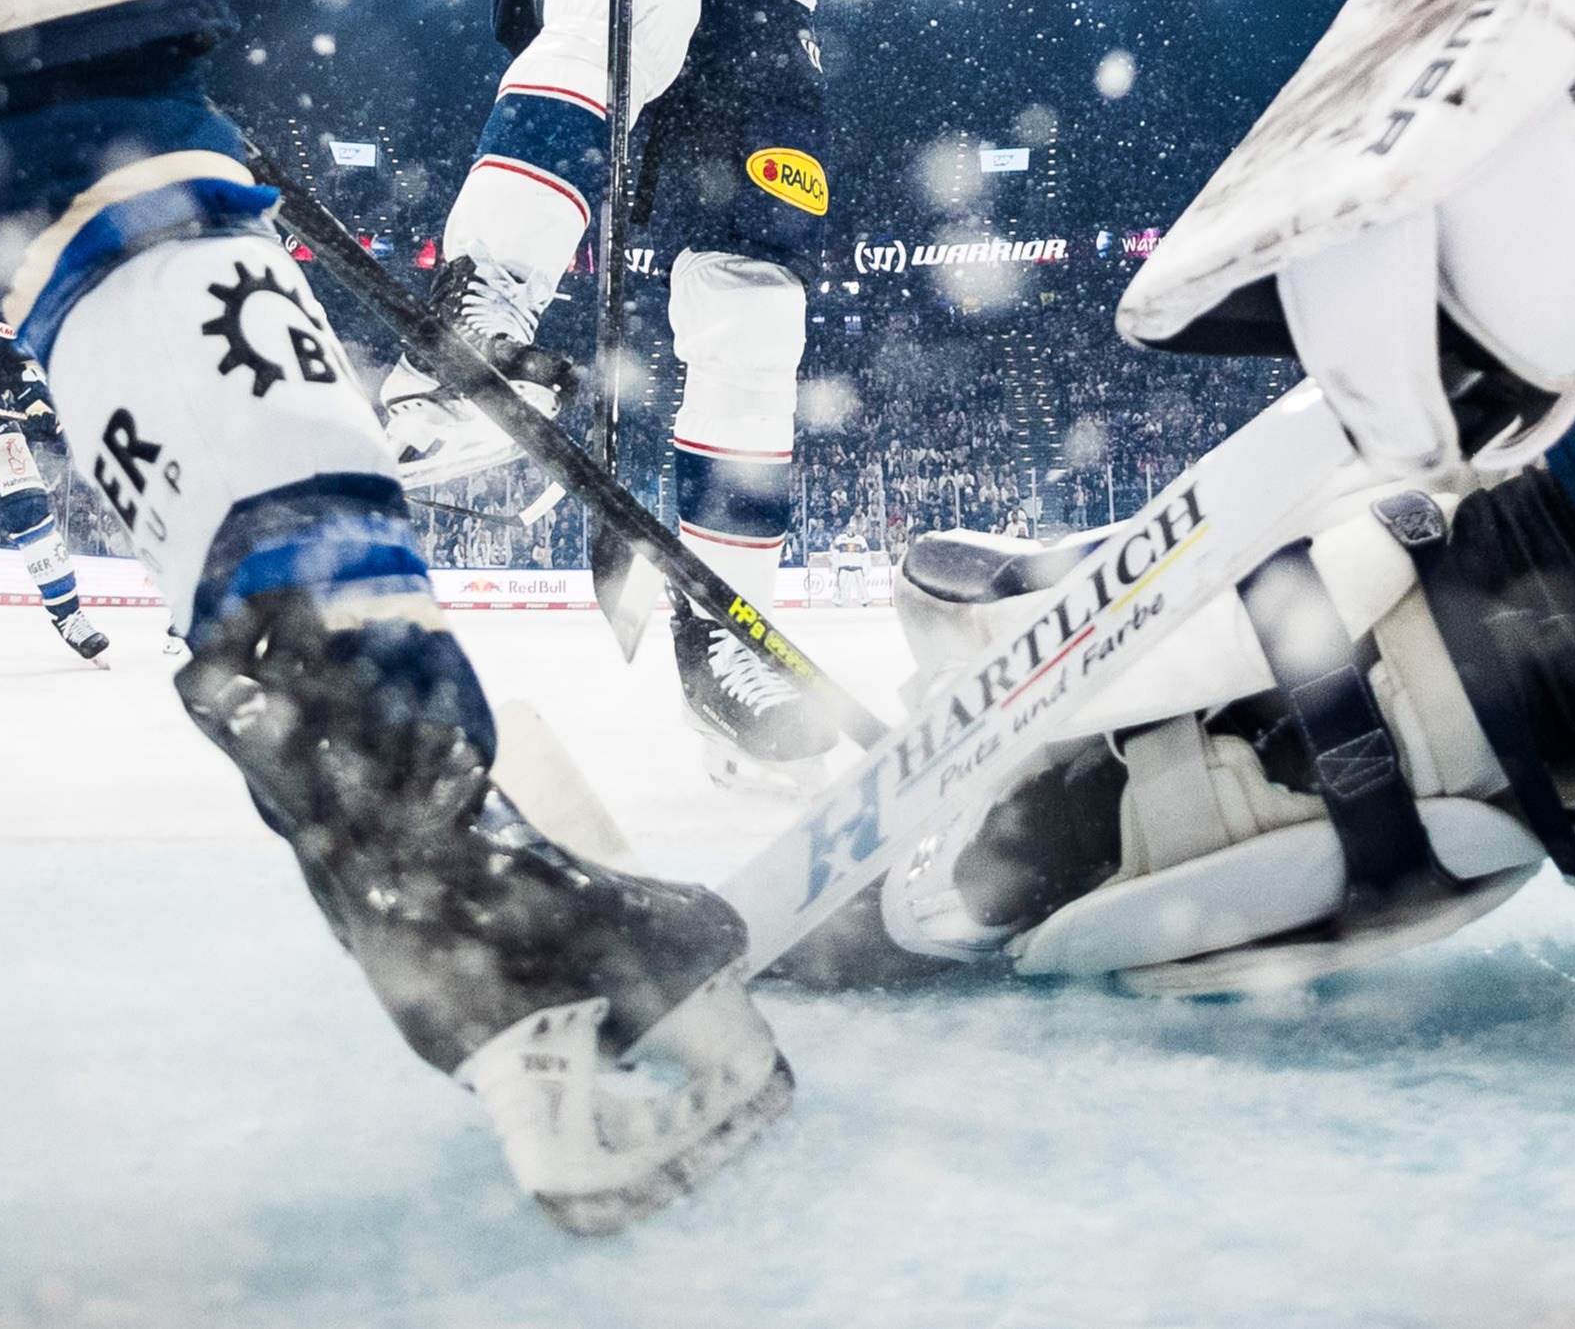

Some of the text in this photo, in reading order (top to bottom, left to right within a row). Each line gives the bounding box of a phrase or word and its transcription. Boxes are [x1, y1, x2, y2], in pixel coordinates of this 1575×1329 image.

[781, 164, 825, 203] RAUCH
[508, 580, 567, 594] Red Bull
[898, 481, 1208, 781] HARTLICH
[1016, 686, 1070, 734] und
[1081, 592, 1167, 678] Farbe
